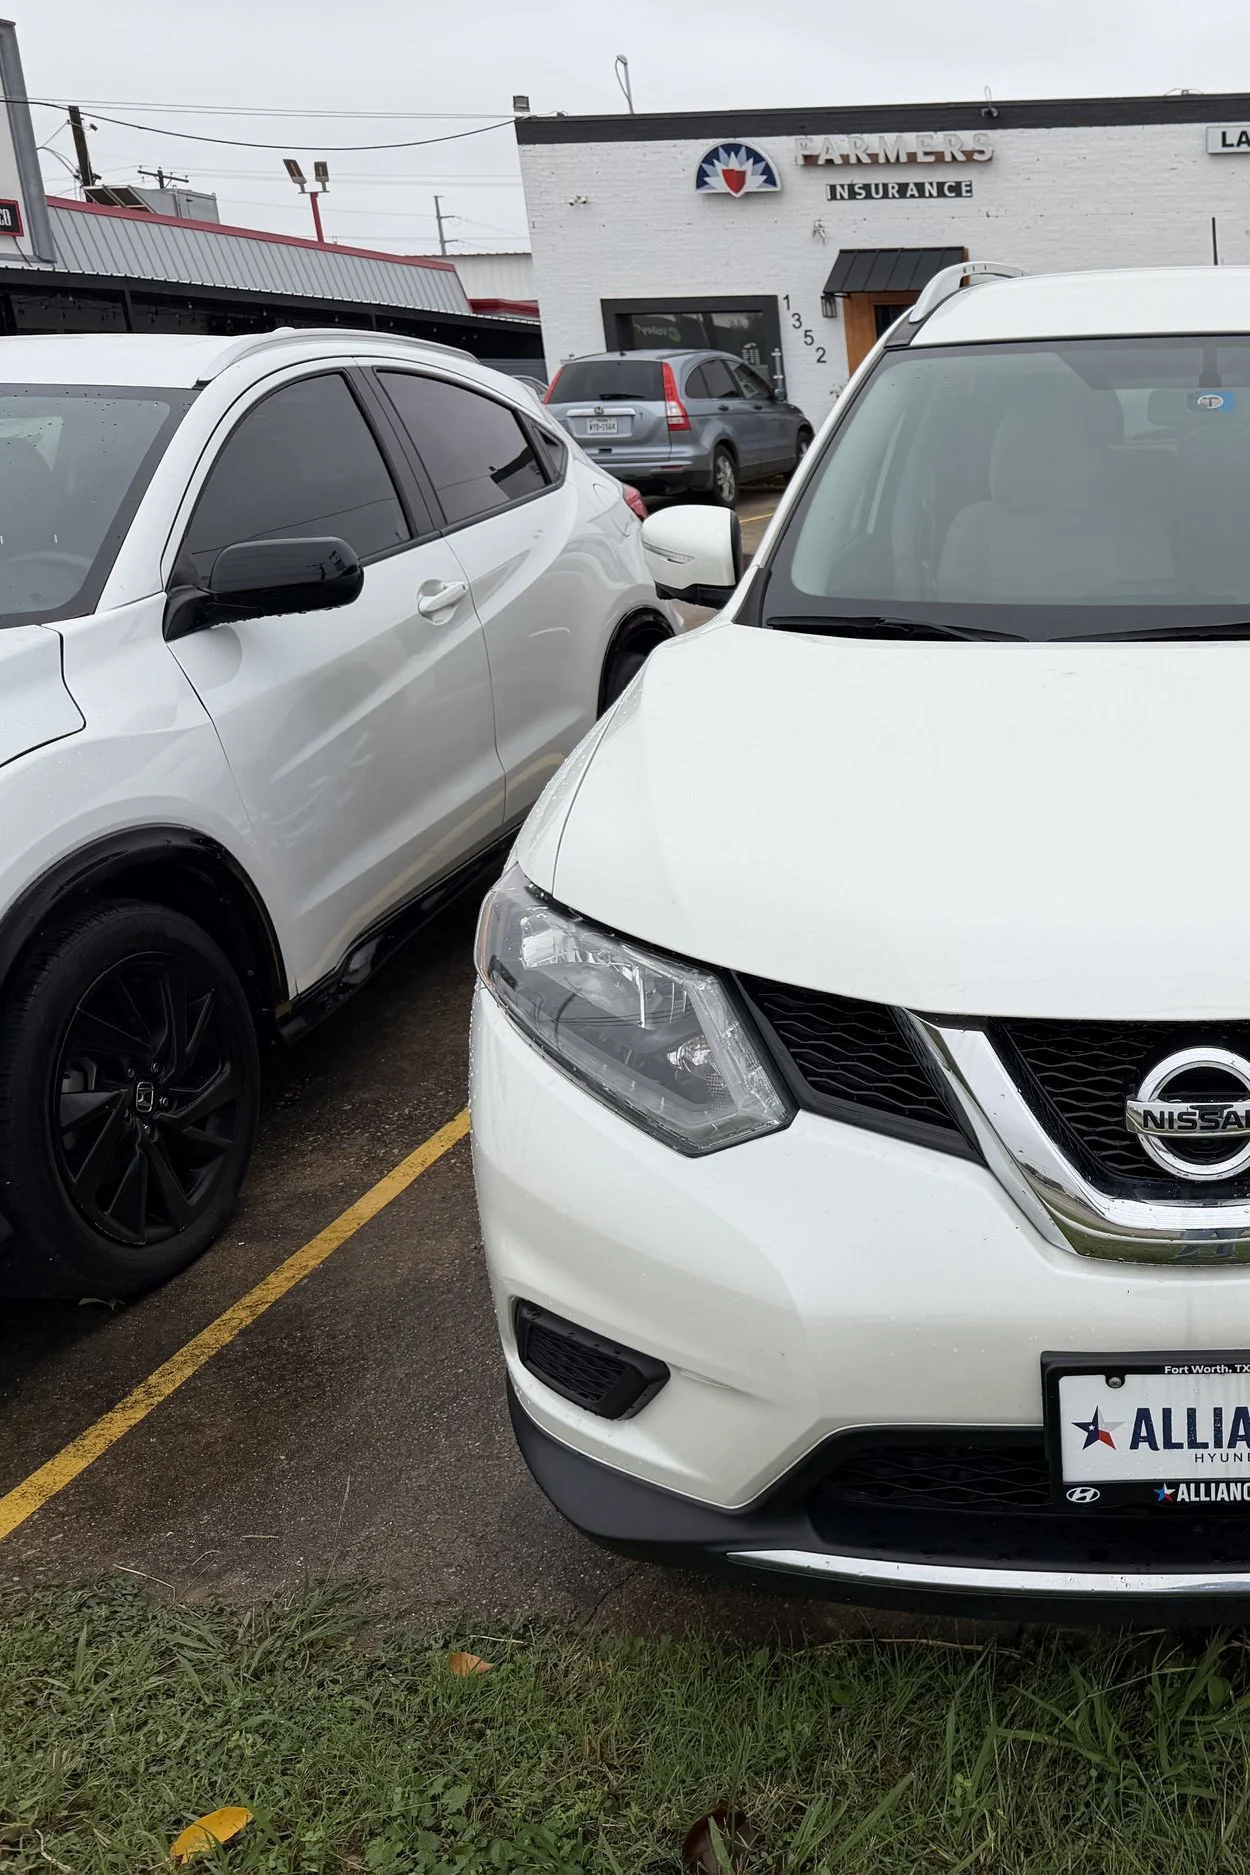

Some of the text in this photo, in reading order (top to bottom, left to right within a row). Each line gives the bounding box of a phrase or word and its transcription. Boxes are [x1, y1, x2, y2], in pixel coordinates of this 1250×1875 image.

[795, 132, 995, 166] FARMERS
[826, 181, 973, 200] INSURANCE
[1164, 1364, 1250, 1374] Fort Worth, TX
